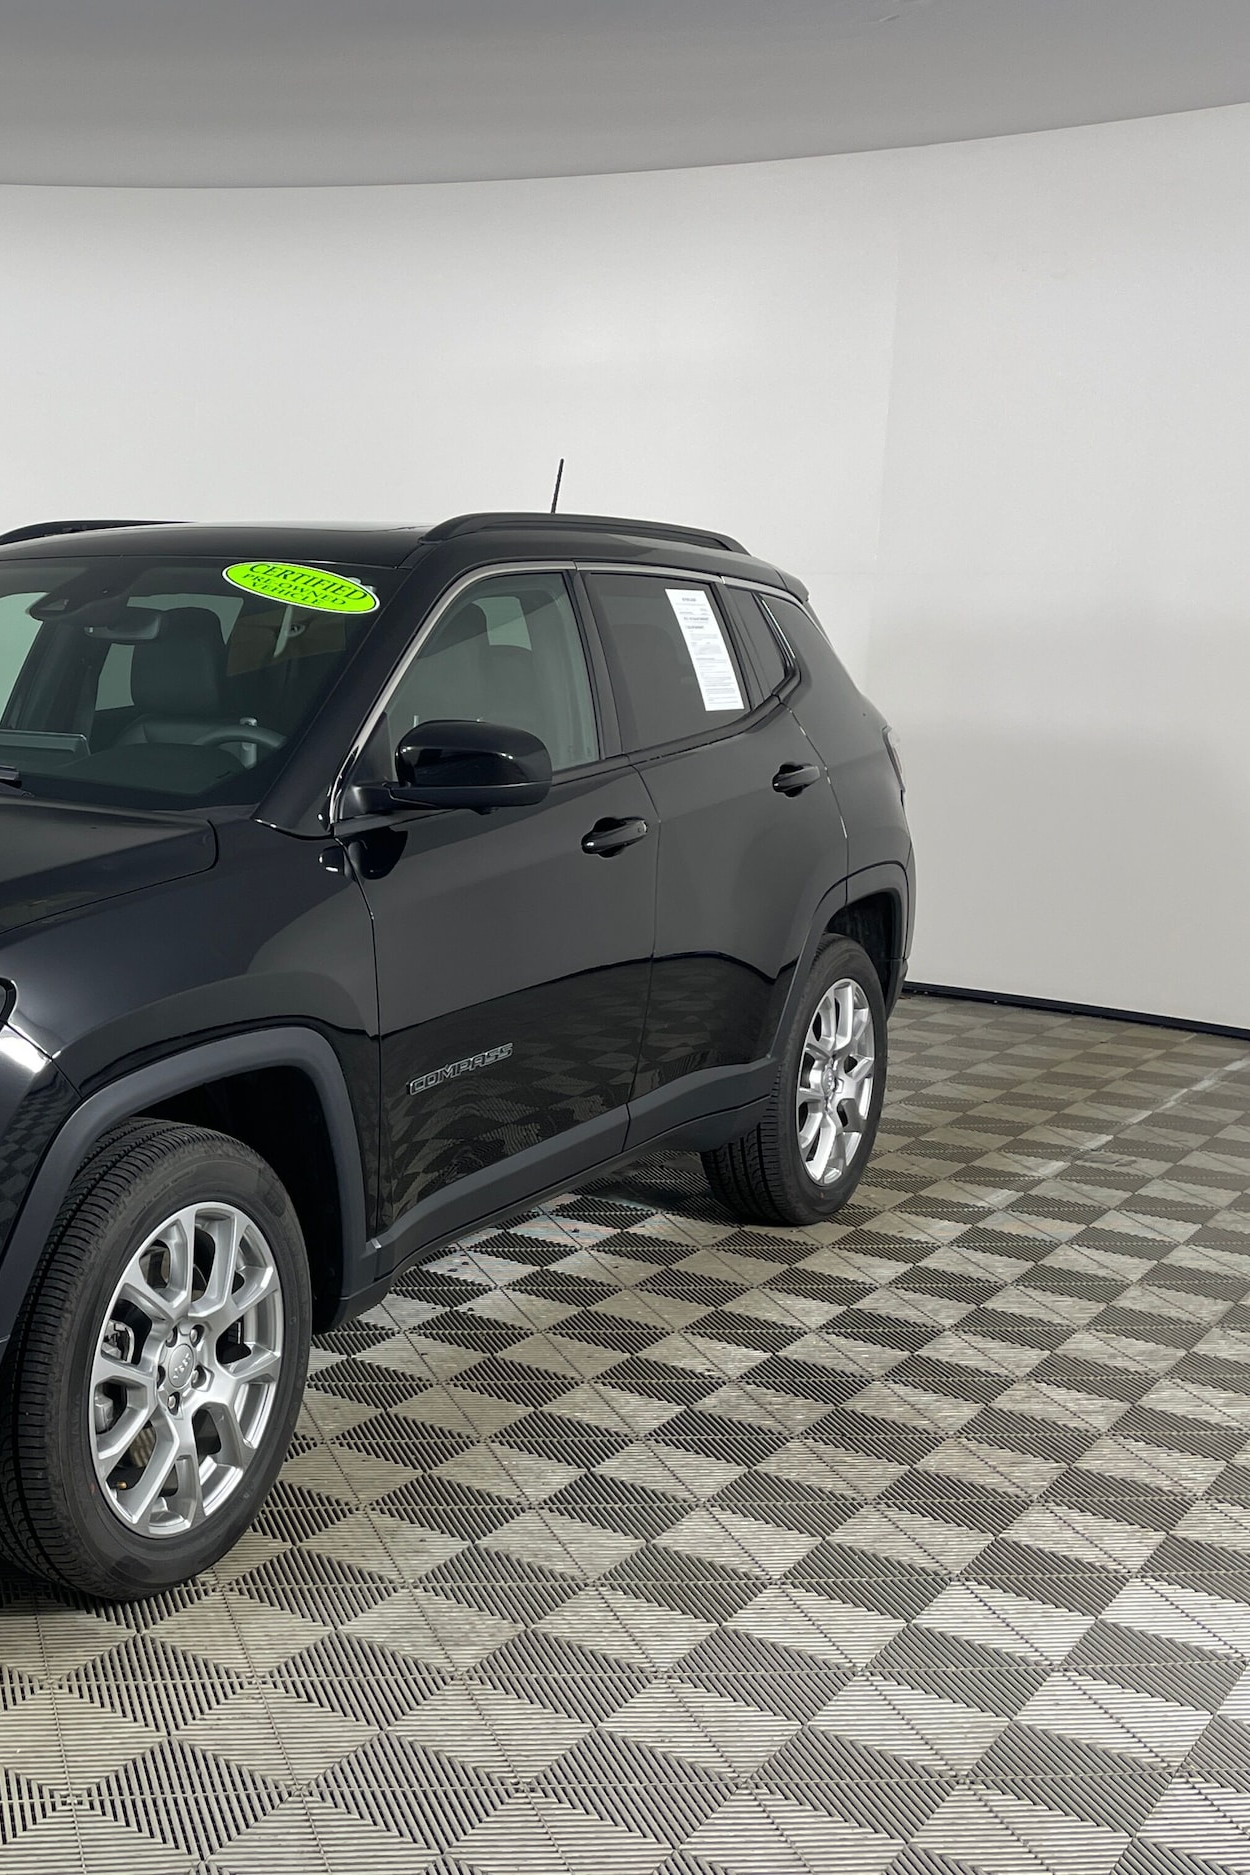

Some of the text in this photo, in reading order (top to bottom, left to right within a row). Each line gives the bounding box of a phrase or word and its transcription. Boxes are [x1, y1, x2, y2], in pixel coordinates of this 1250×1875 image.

[241, 573, 347, 606] PRE-OWNED
[249, 563, 368, 601] CERTIFIED
[249, 582, 322, 606] VEHICLE
[409, 1042, 513, 1096] COMPASS
